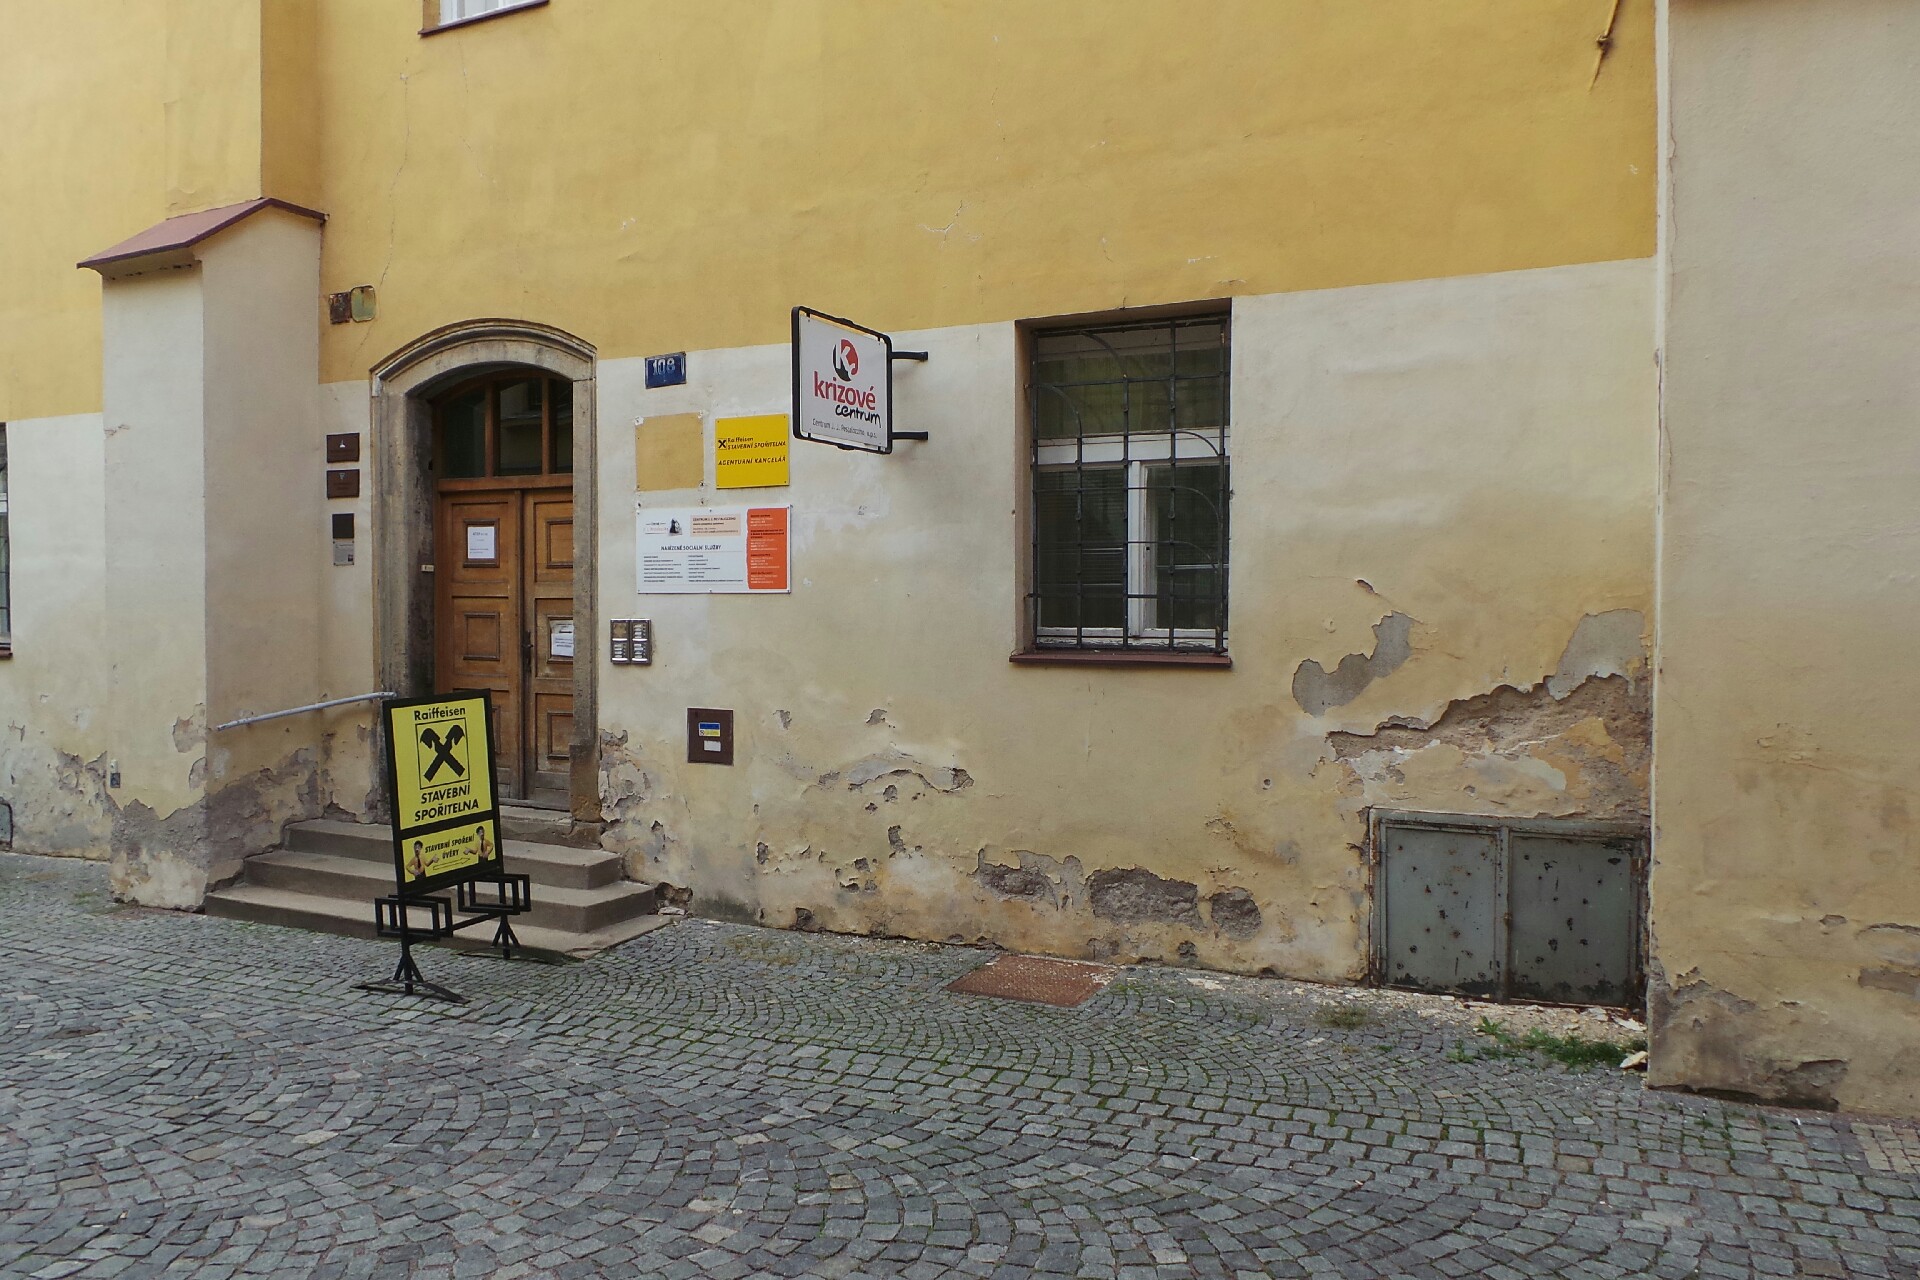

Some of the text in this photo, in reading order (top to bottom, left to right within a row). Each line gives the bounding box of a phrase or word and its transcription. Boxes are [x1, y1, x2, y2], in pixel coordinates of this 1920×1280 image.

[652, 357, 676, 375] 108
[813, 370, 876, 411] krizové
[835, 403, 882, 429] centrum
[727, 442, 753, 450] STAVEBNÍ
[717, 455, 786, 466] AGENTURNÍ KANCELÁŘ
[414, 706, 466, 721] Raiffeisen
[421, 781, 471, 804] STAVEBNÍ
[414, 798, 479, 822] SPOŘITELNA
[425, 833, 475, 853] STAVEBNÍ SPOŘENÍ
[442, 848, 460, 859] ÚVĚRY
